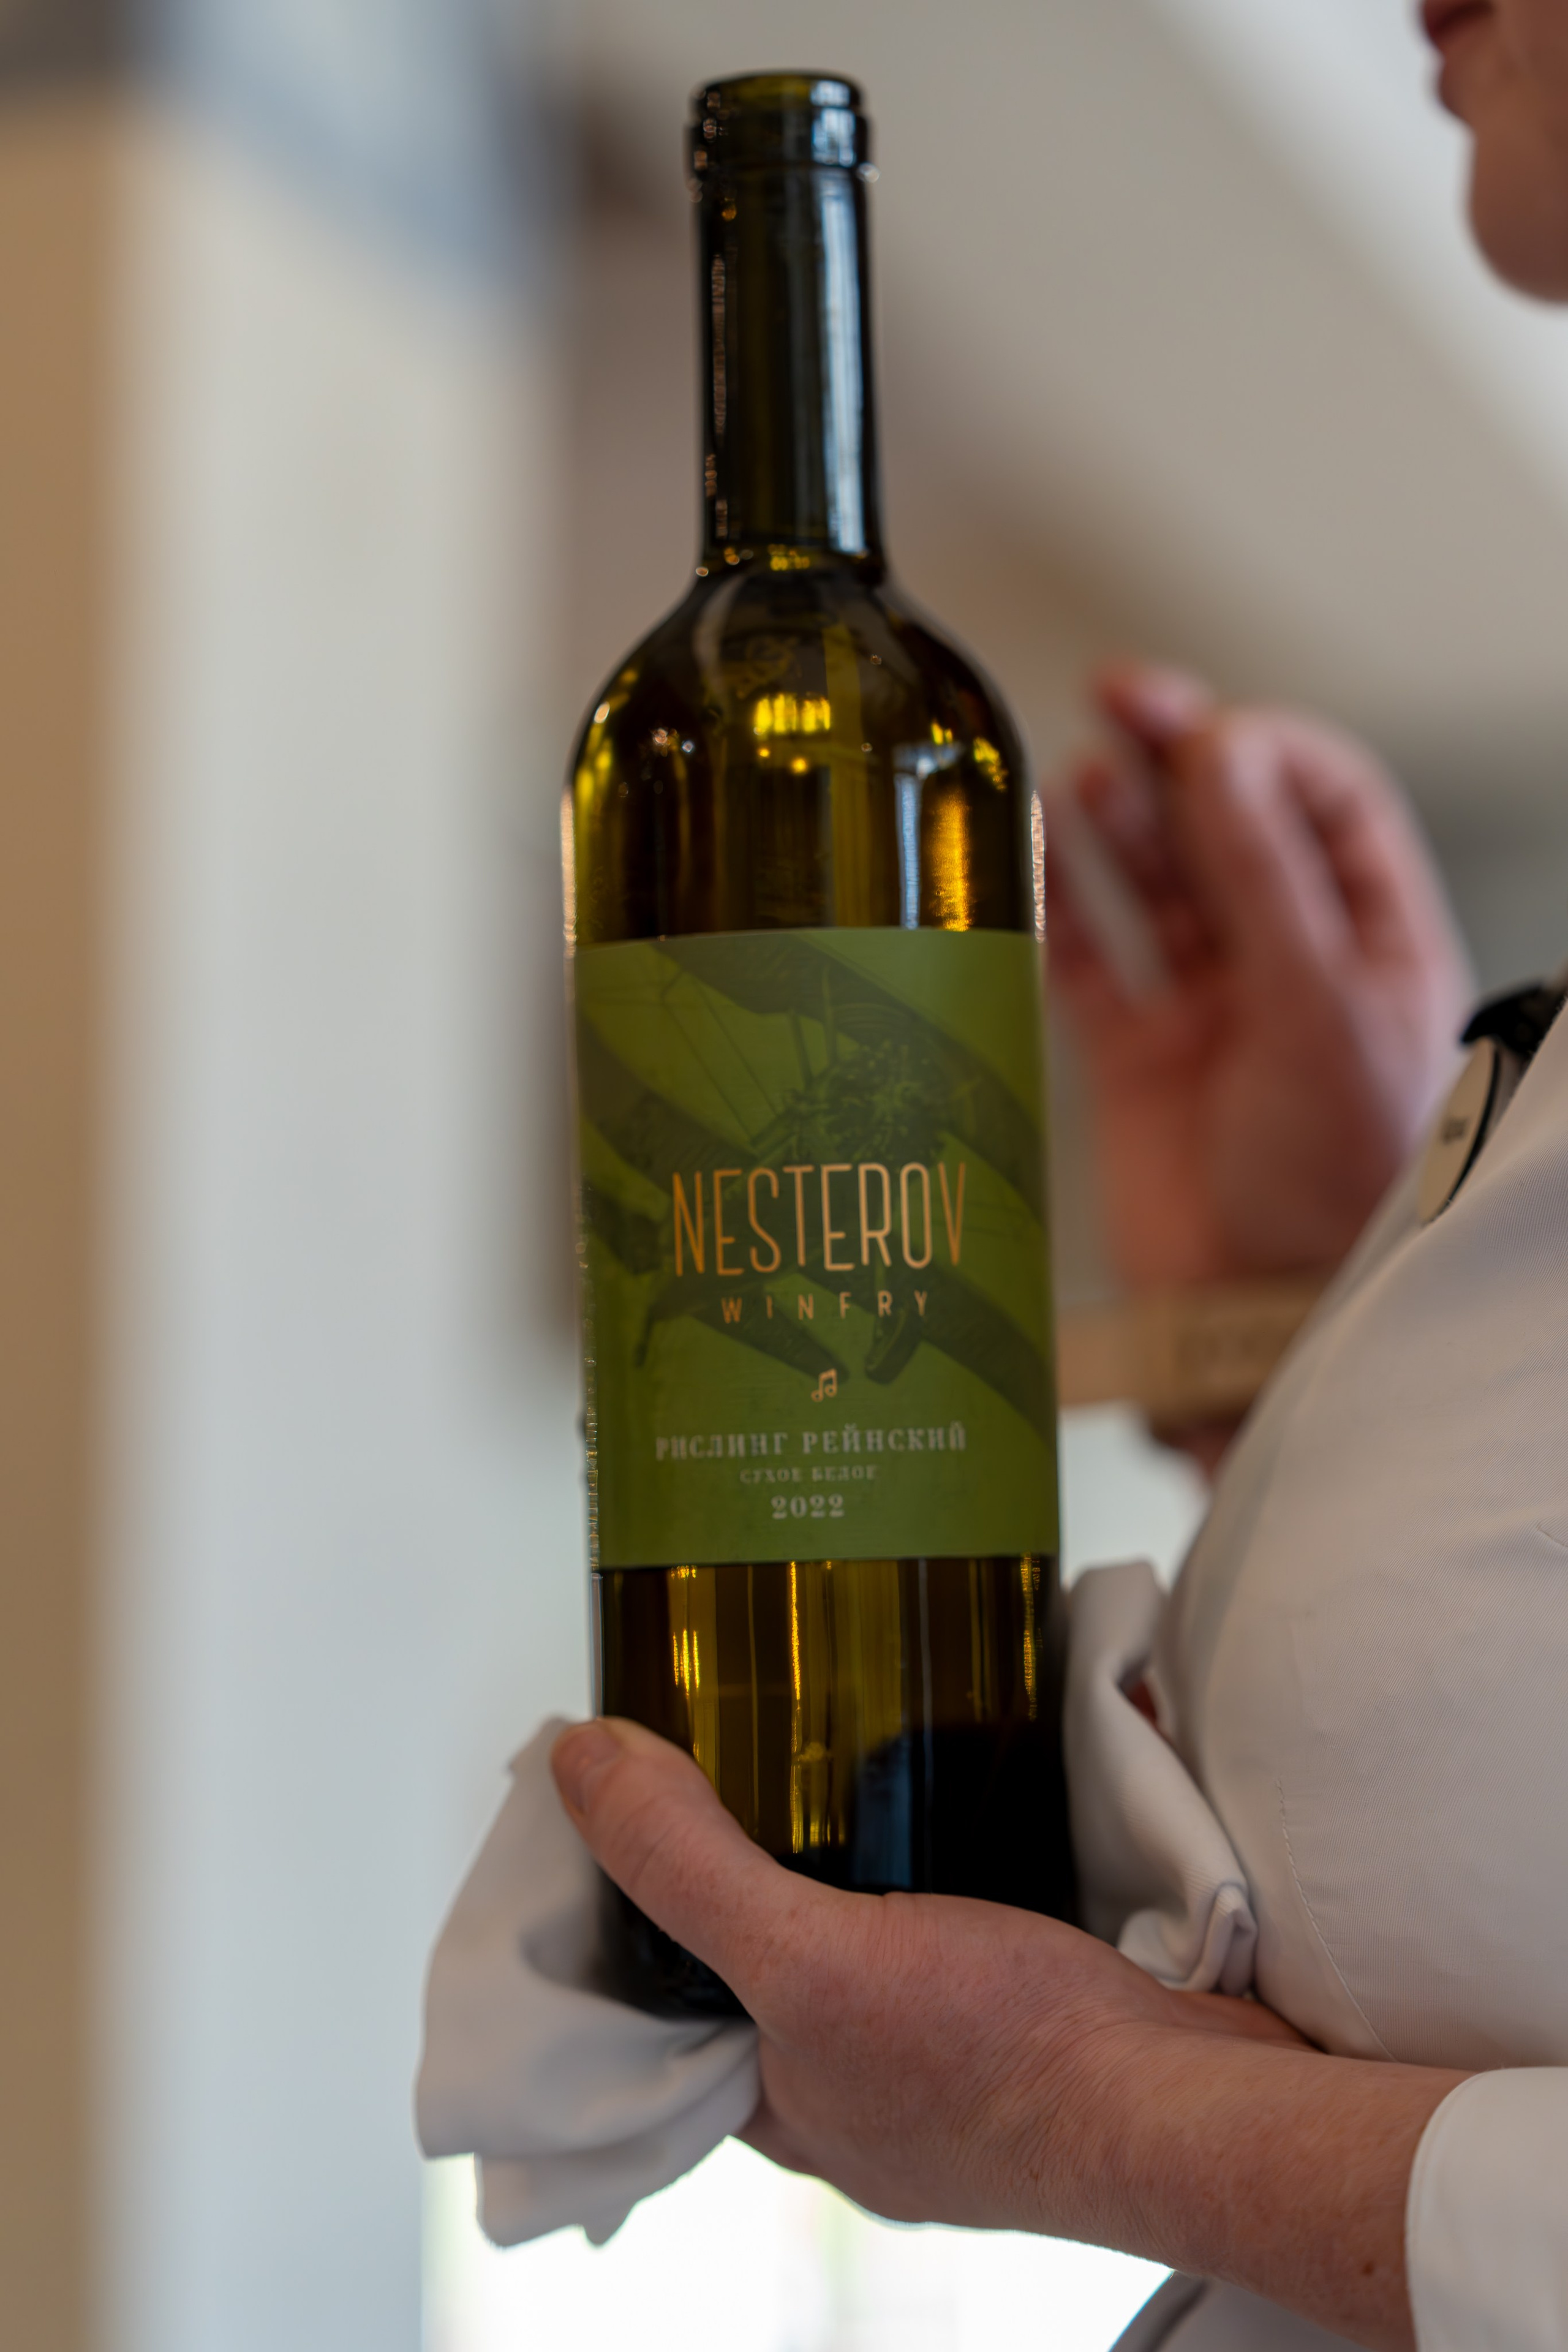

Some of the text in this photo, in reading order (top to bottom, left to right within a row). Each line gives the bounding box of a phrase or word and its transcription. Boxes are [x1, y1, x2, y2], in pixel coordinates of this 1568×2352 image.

[673, 1162, 965, 1276] NESTEROV
[656, 1420, 966, 1461] РИСЛИНГ РЕЙНСКИЙ
[771, 1494, 844, 1519] 2022
